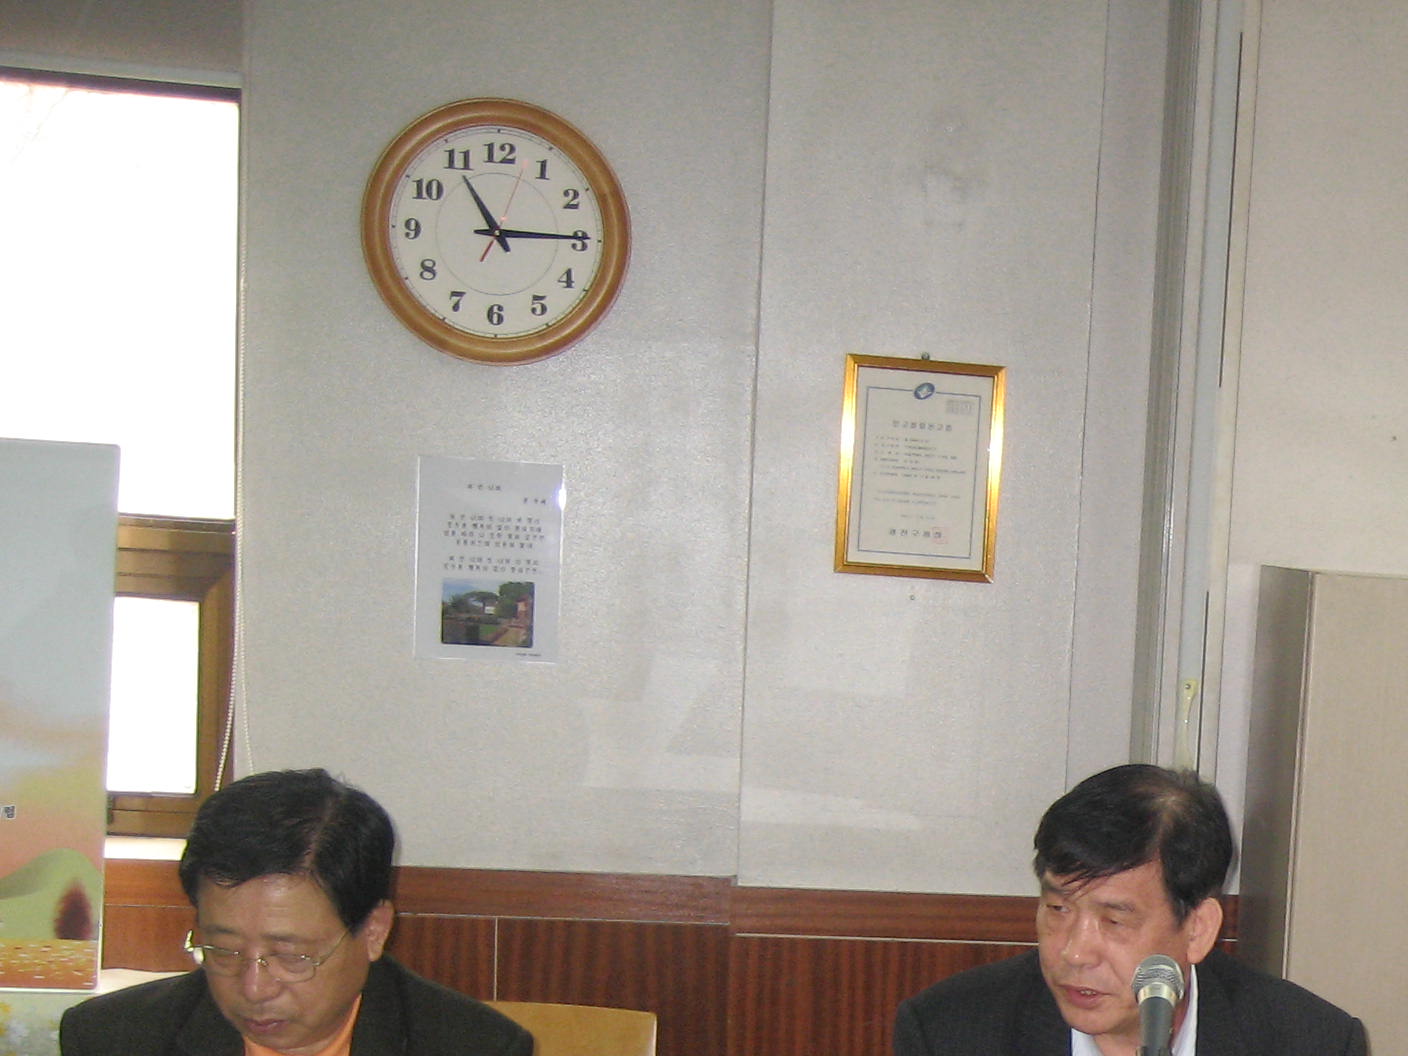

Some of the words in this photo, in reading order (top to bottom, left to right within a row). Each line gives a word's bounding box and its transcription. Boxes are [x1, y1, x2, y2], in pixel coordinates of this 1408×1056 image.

[443, 148, 474, 171] 11
[483, 142, 516, 164] 12
[535, 159, 550, 181] 1
[412, 178, 444, 201] 10
[562, 188, 580, 210] 2
[404, 217, 421, 239] 9
[571, 230, 588, 252] 3
[419, 258, 437, 280] 8
[557, 268, 575, 289] 4
[449, 290, 467, 313] 7
[530, 294, 547, 316] 5
[487, 303, 504, 326] 6
